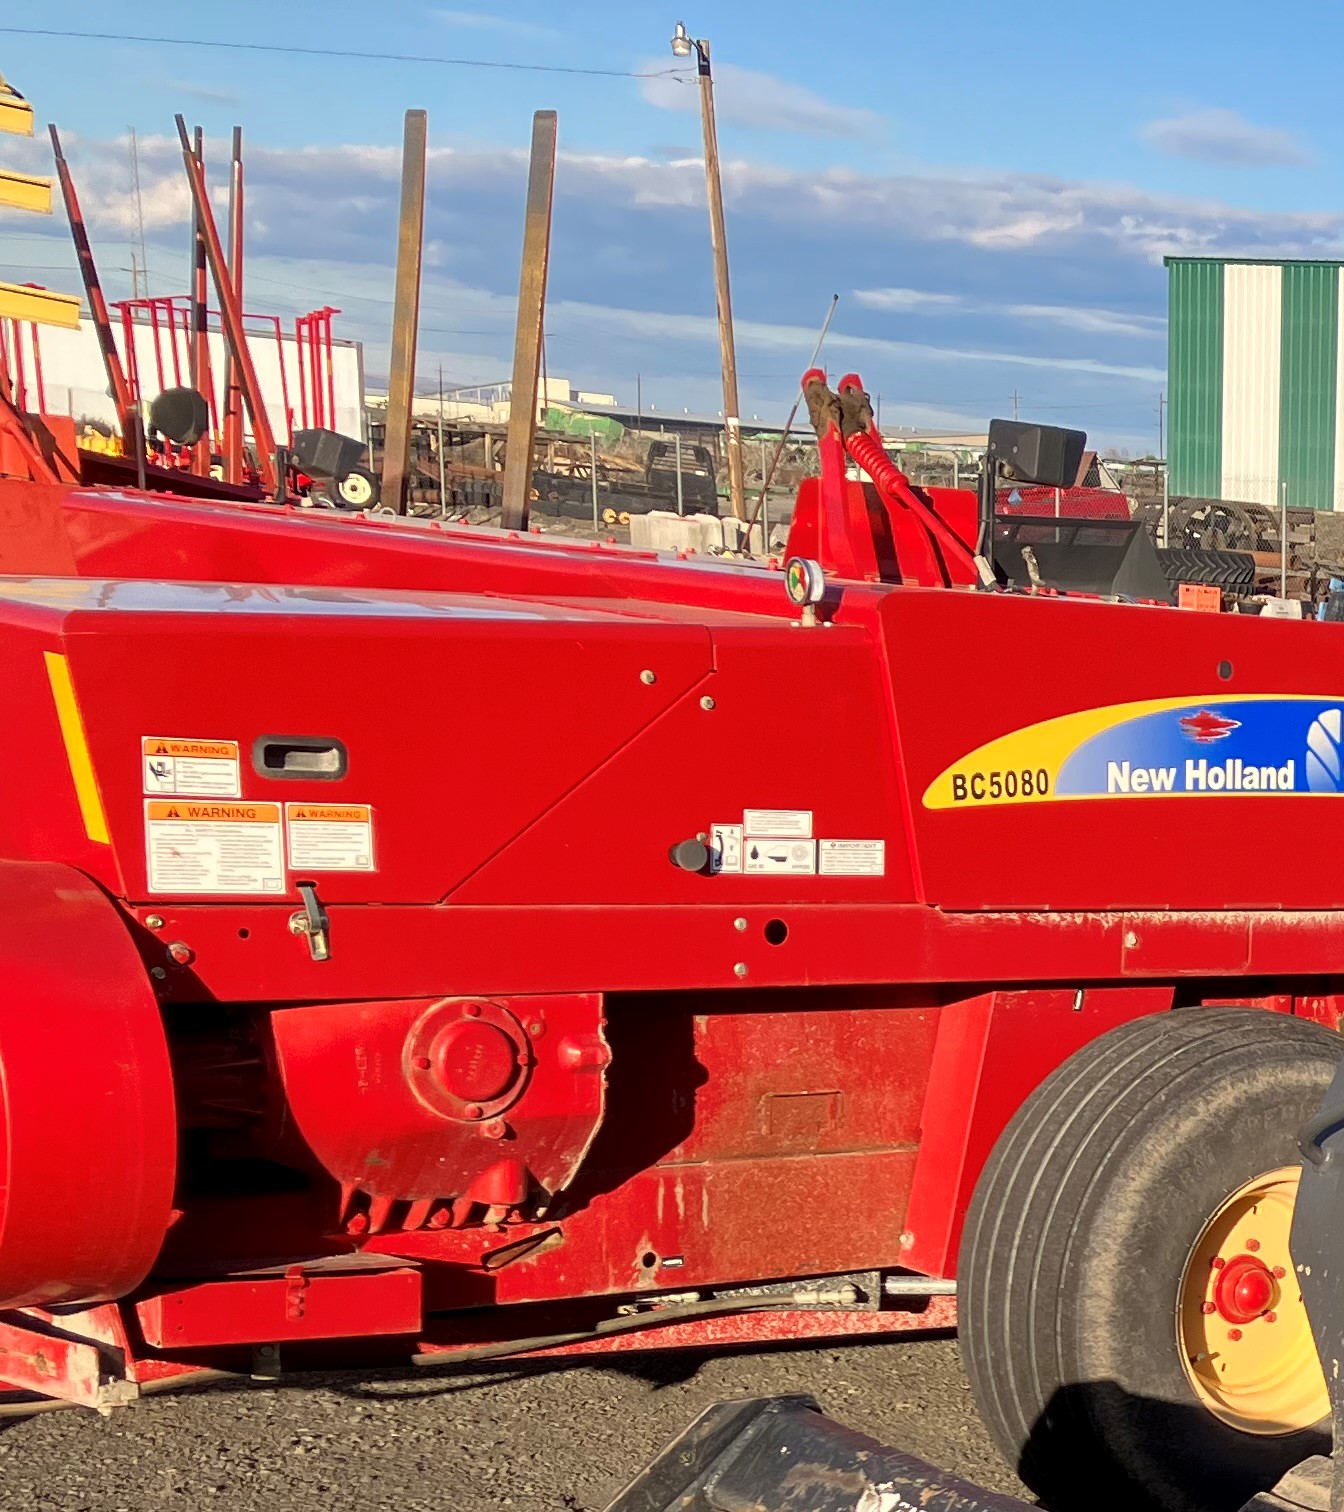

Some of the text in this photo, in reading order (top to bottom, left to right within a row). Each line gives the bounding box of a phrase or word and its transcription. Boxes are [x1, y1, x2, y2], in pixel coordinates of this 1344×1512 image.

[170, 744, 230, 756] WARNING
[1106, 758, 1295, 794] New Holland
[951, 767, 1050, 801] BC5080
[187, 806, 257, 819] WARNING
[308, 809, 362, 819] WARNING
